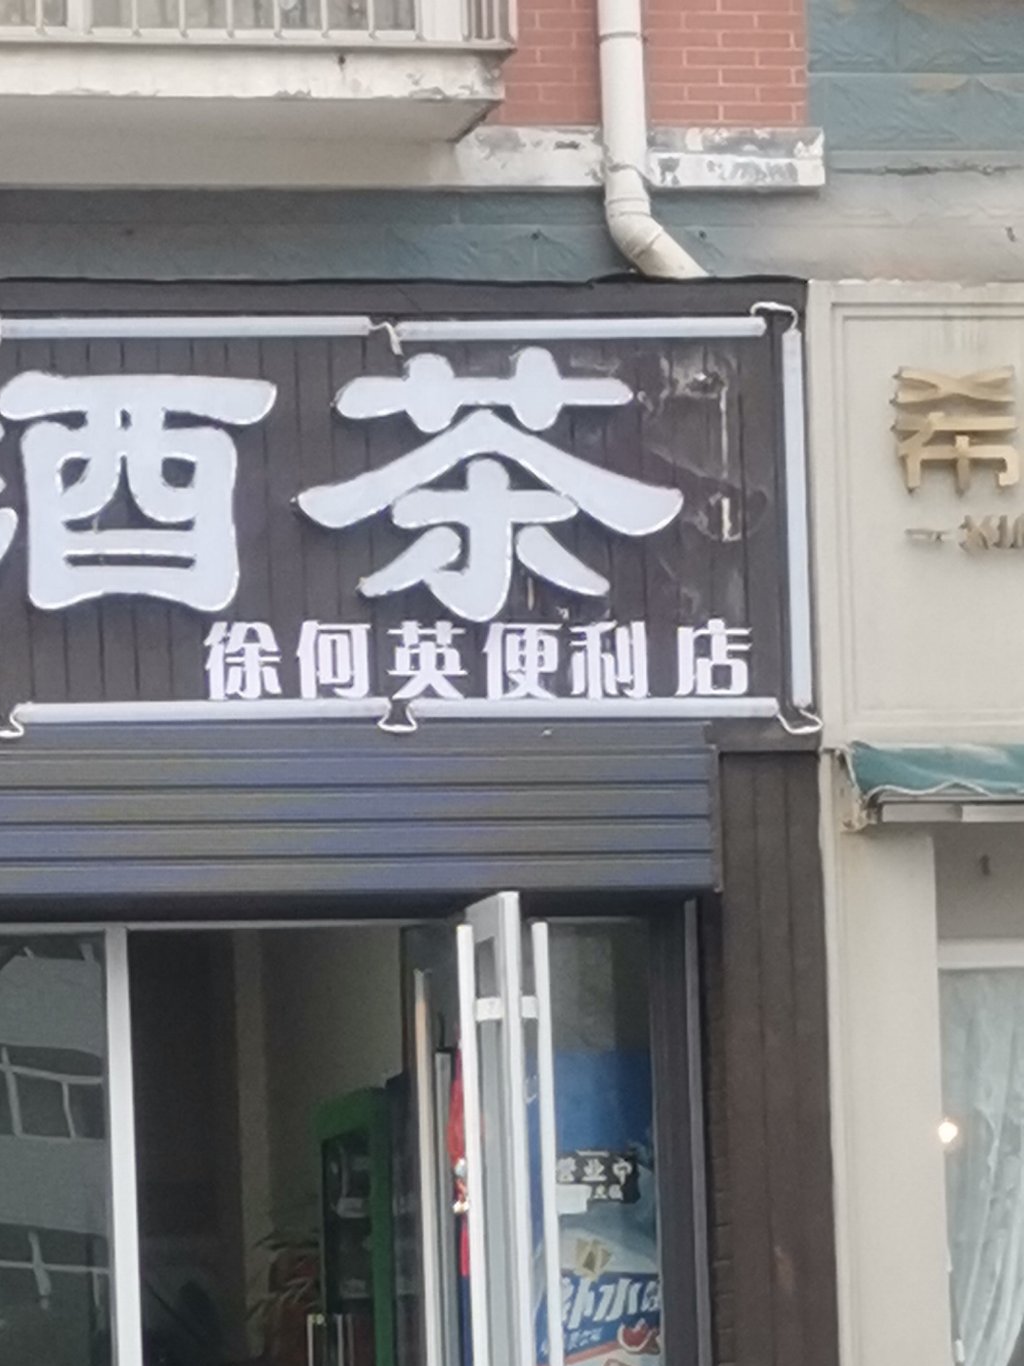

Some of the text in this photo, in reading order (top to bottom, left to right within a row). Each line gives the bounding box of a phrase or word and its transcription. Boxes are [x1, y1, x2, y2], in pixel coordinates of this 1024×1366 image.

[203, 618, 753, 700] 徐何英便利店
